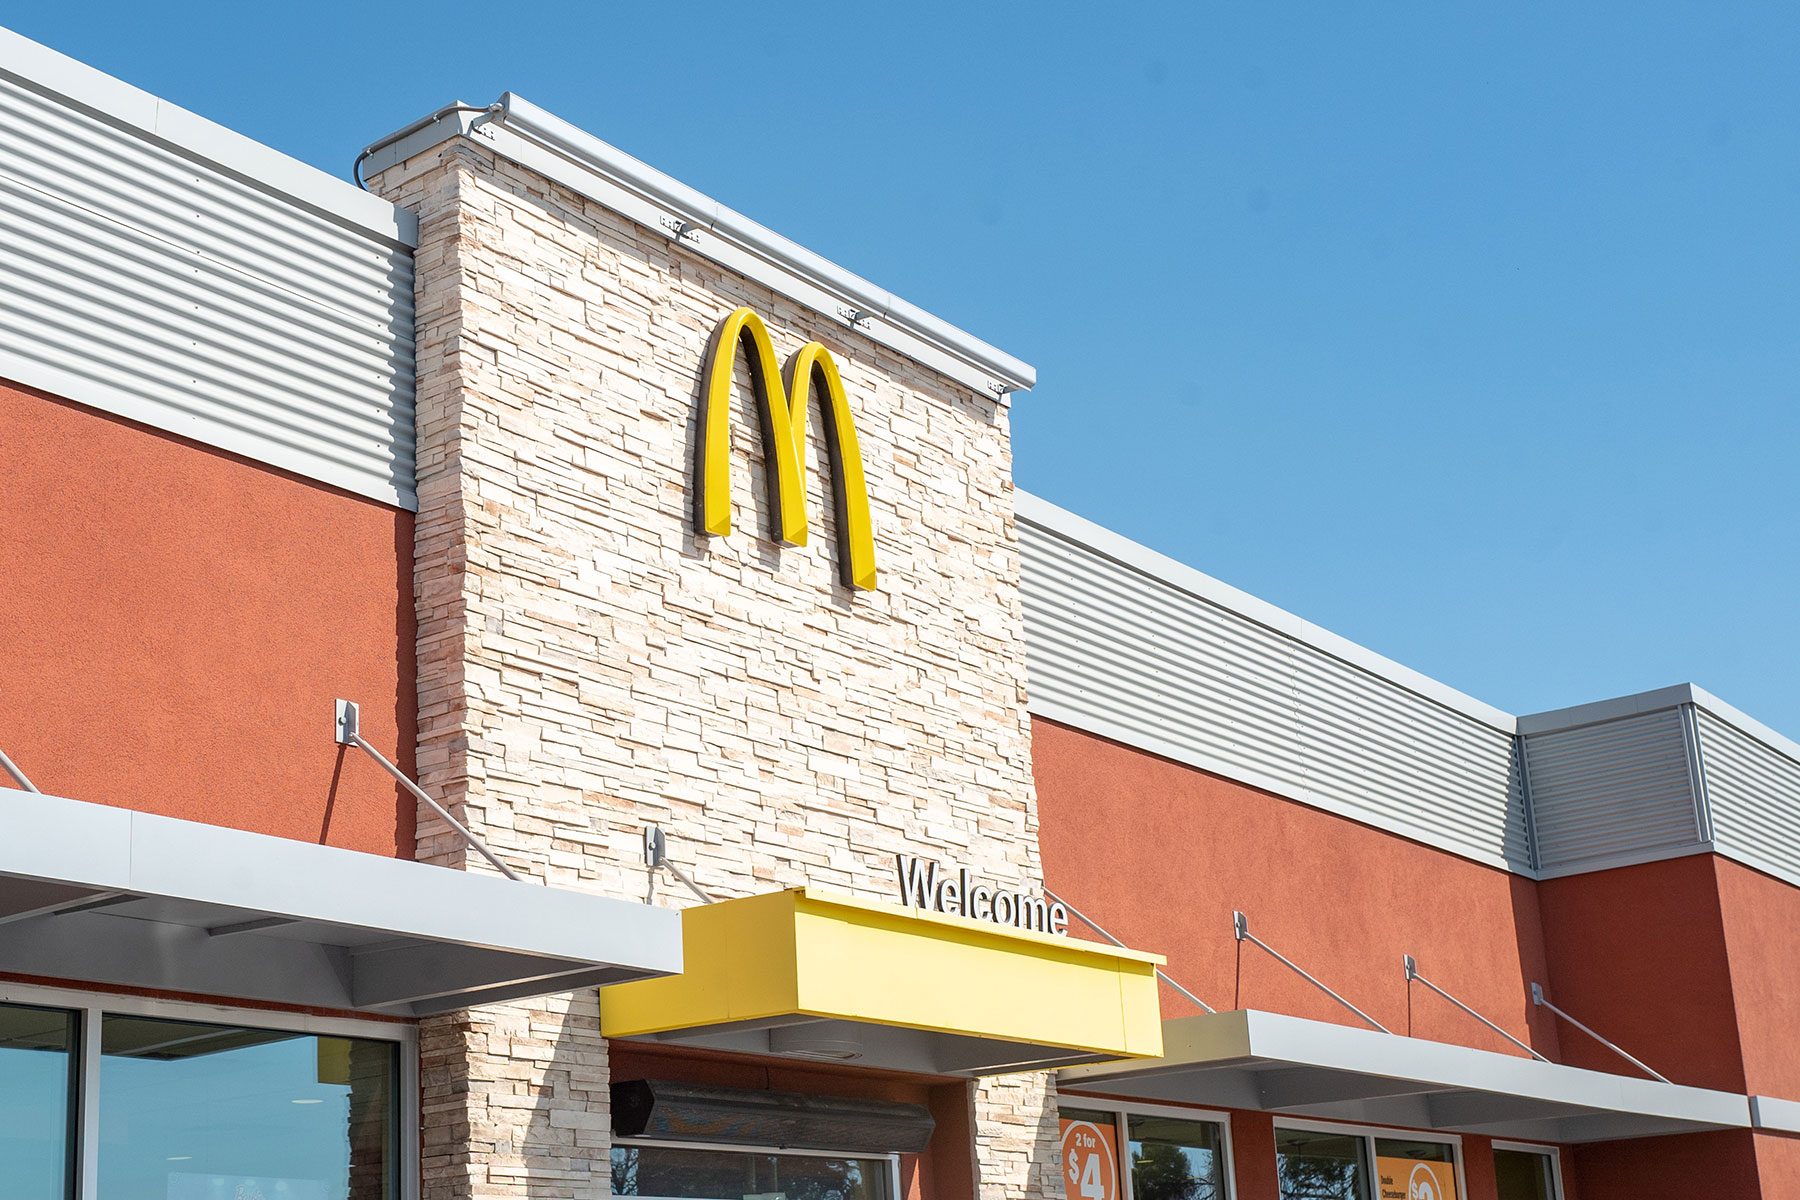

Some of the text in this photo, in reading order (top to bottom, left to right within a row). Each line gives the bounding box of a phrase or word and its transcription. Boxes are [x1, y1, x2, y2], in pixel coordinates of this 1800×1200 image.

[896, 854, 1069, 937] Welcome
[1075, 1133, 1096, 1148] 2 for
[1068, 1148, 1105, 1200] $4
